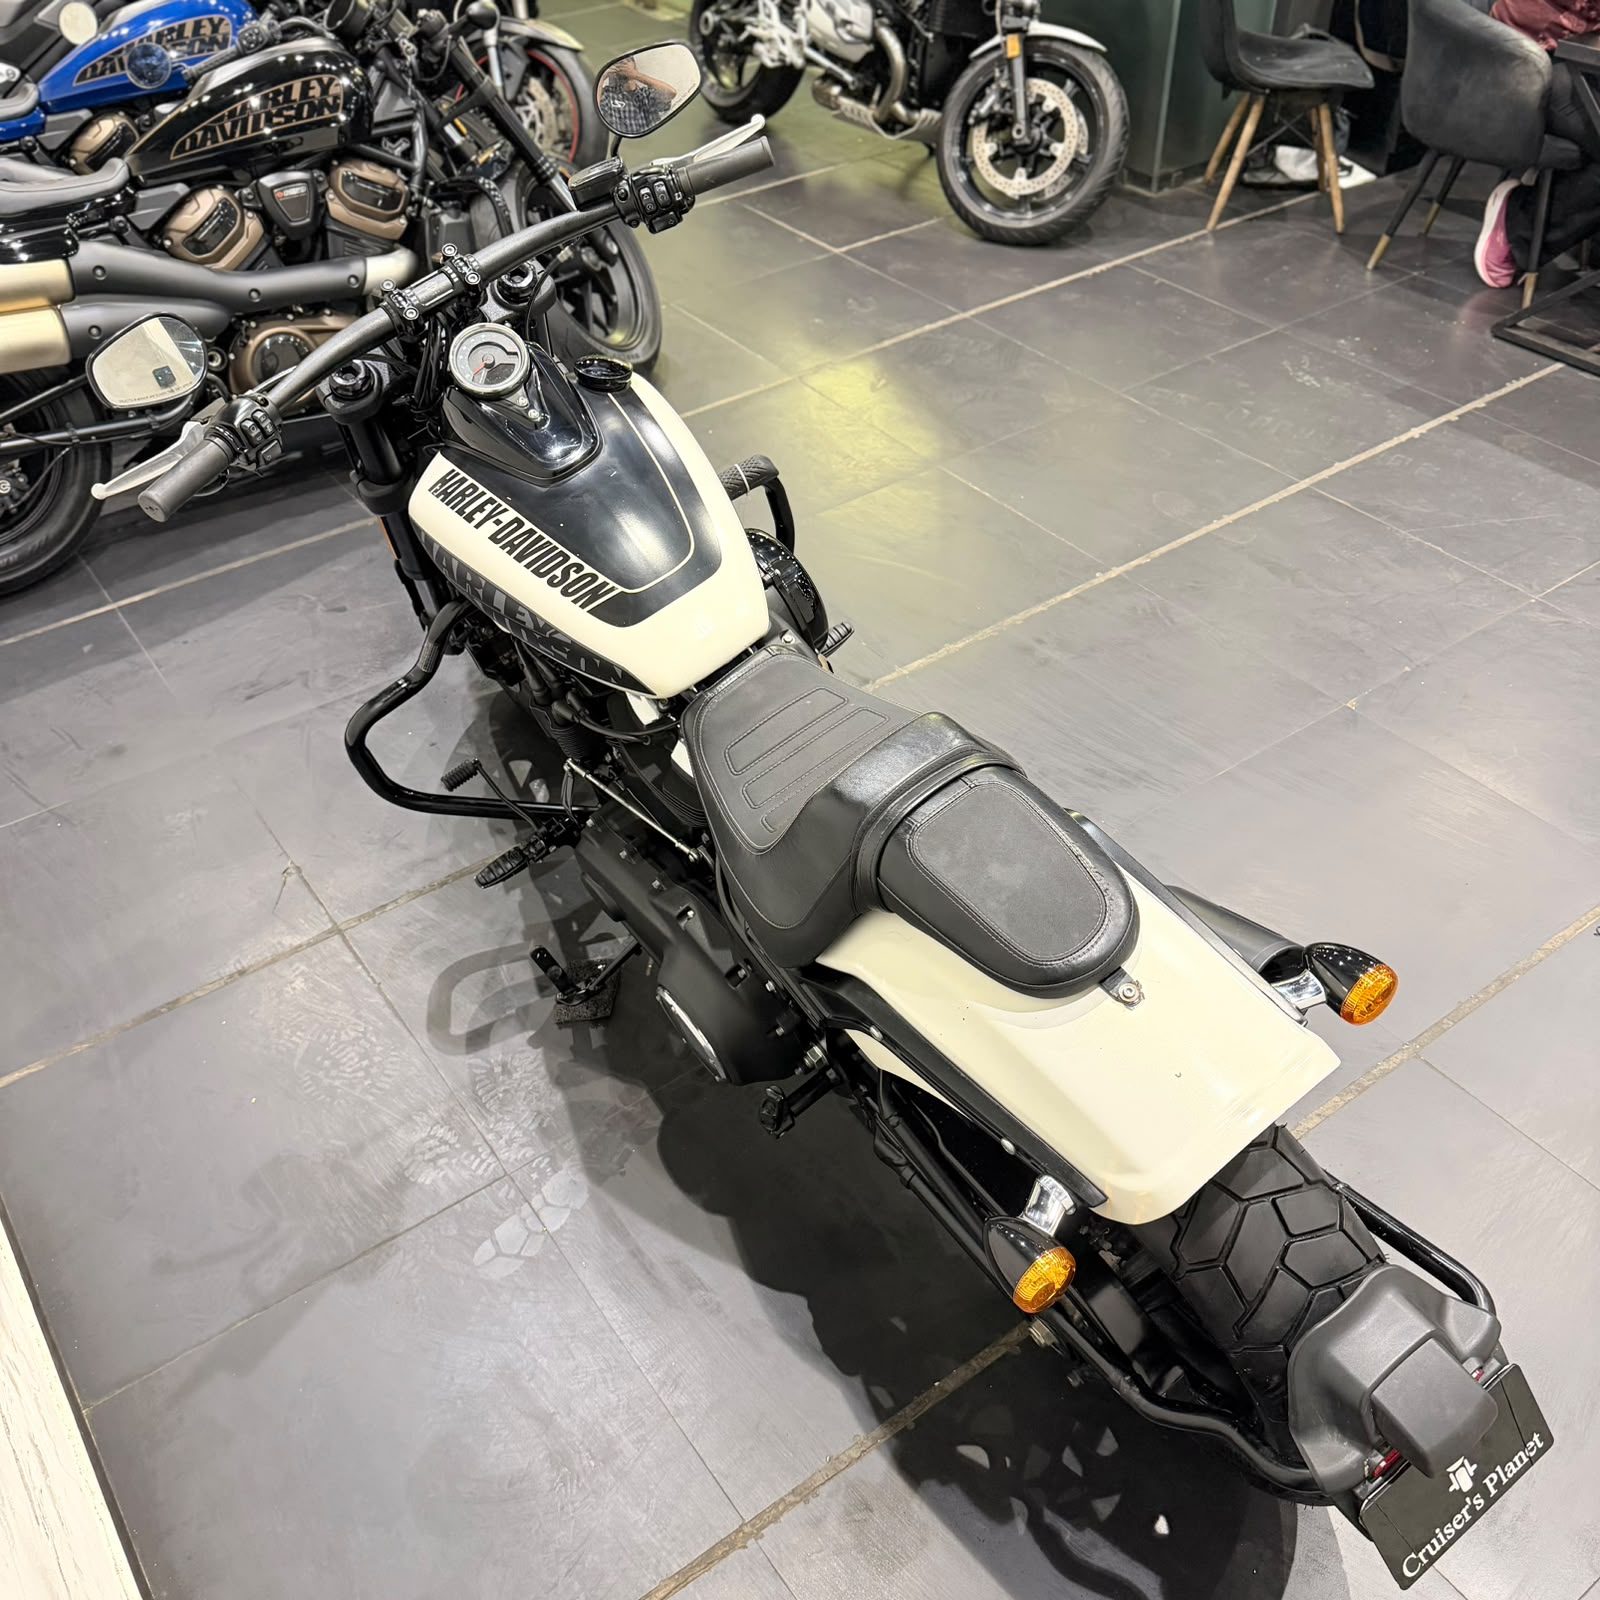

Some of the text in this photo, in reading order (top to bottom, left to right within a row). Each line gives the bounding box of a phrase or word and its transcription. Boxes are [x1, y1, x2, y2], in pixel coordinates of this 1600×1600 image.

[428, 469, 616, 610] HARLEY-DAVIDSON
[1402, 1432, 1544, 1578] Cruiser's Planet
